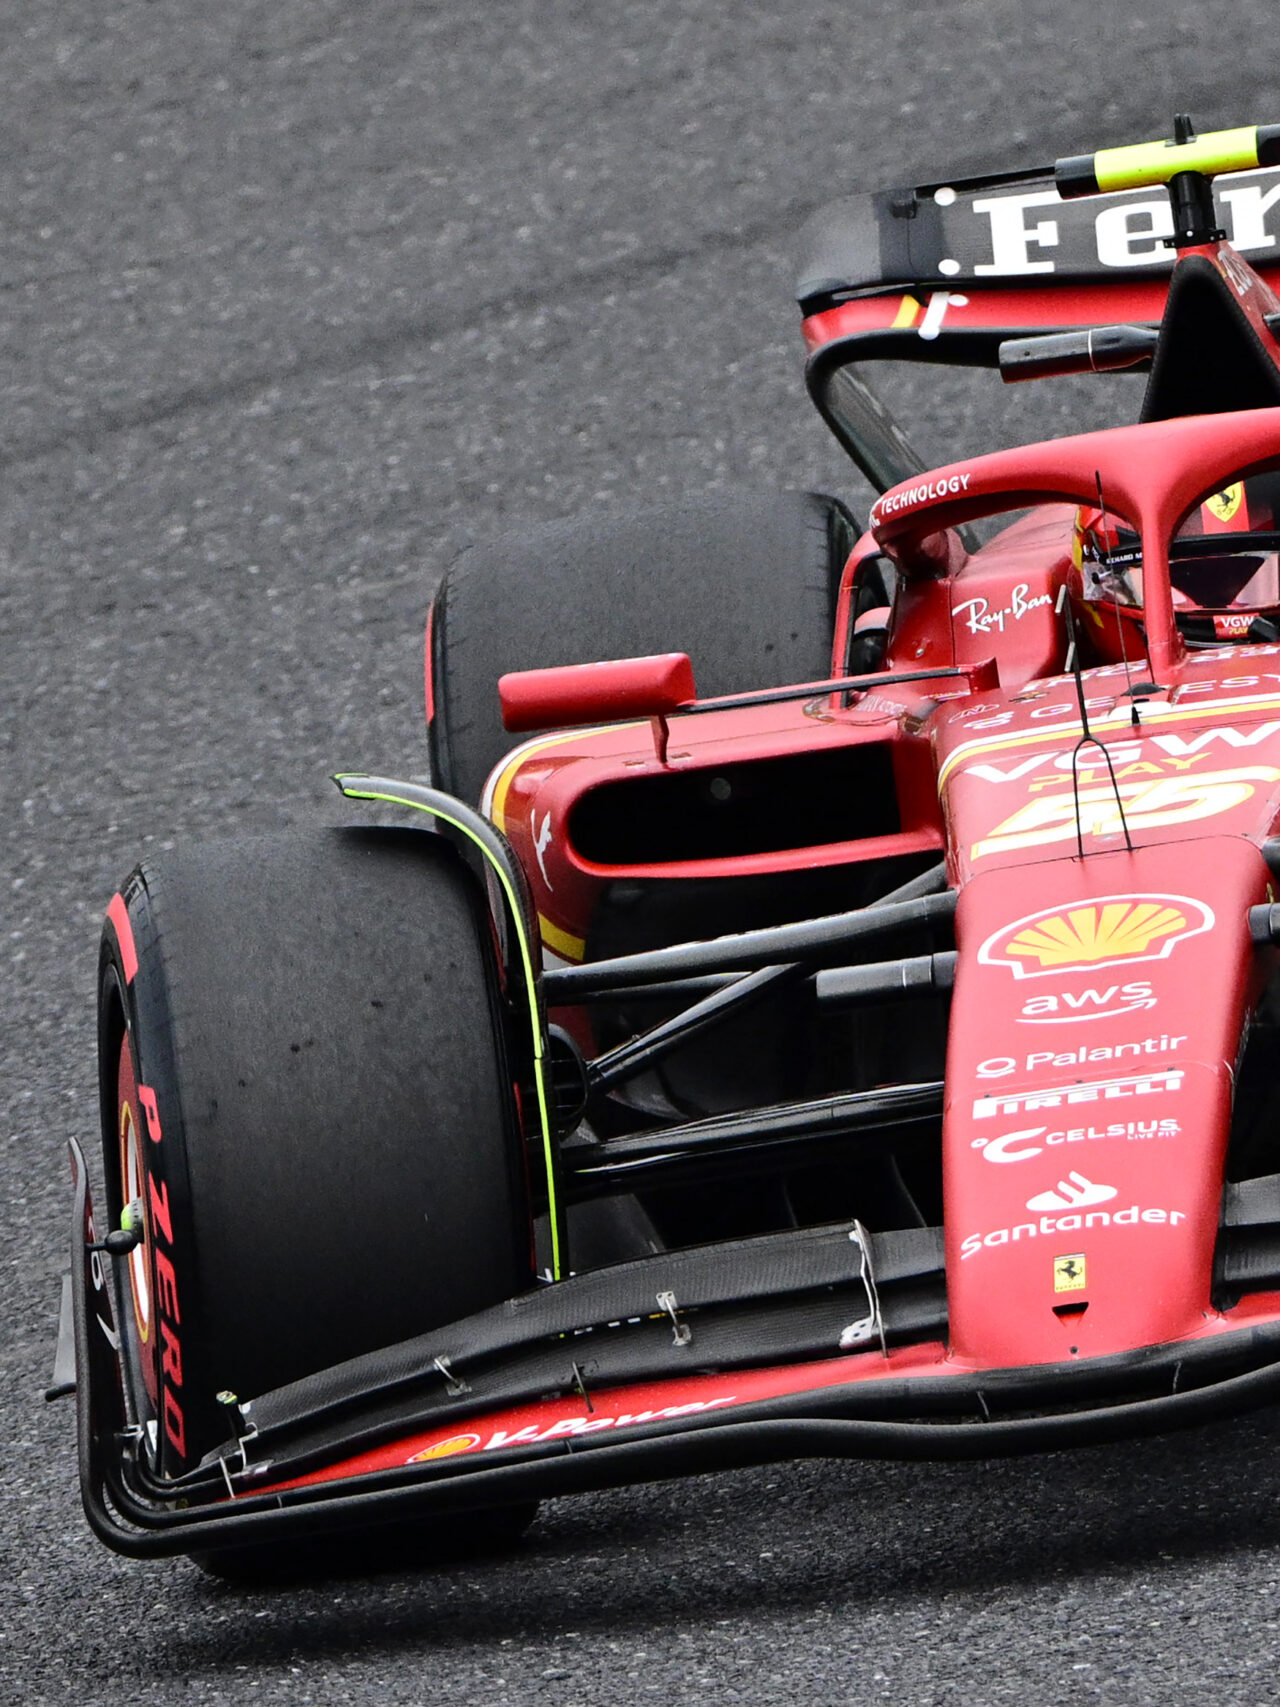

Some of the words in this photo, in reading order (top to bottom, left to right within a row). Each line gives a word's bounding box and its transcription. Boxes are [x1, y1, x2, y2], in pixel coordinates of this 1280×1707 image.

[882, 473, 970, 515] TECHNOLOGY
[952, 583, 1052, 633] Ray-Ban
[1221, 616, 1254, 628] VGW
[1028, 752, 1207, 792] PLAY
[1021, 981, 1154, 1015] aws
[1027, 1034, 1187, 1071] Palantir
[138, 1084, 162, 1143] P
[972, 1070, 1185, 1119] PIRELLI
[1046, 1118, 1180, 1145] CELSIUS
[1127, 1131, 1154, 1140] LIVE
[1158, 1130, 1177, 1138] FIT
[961, 1206, 1185, 1260] Santander
[149, 1171, 186, 1458] ZERO
[483, 1396, 736, 1450] V-Power
